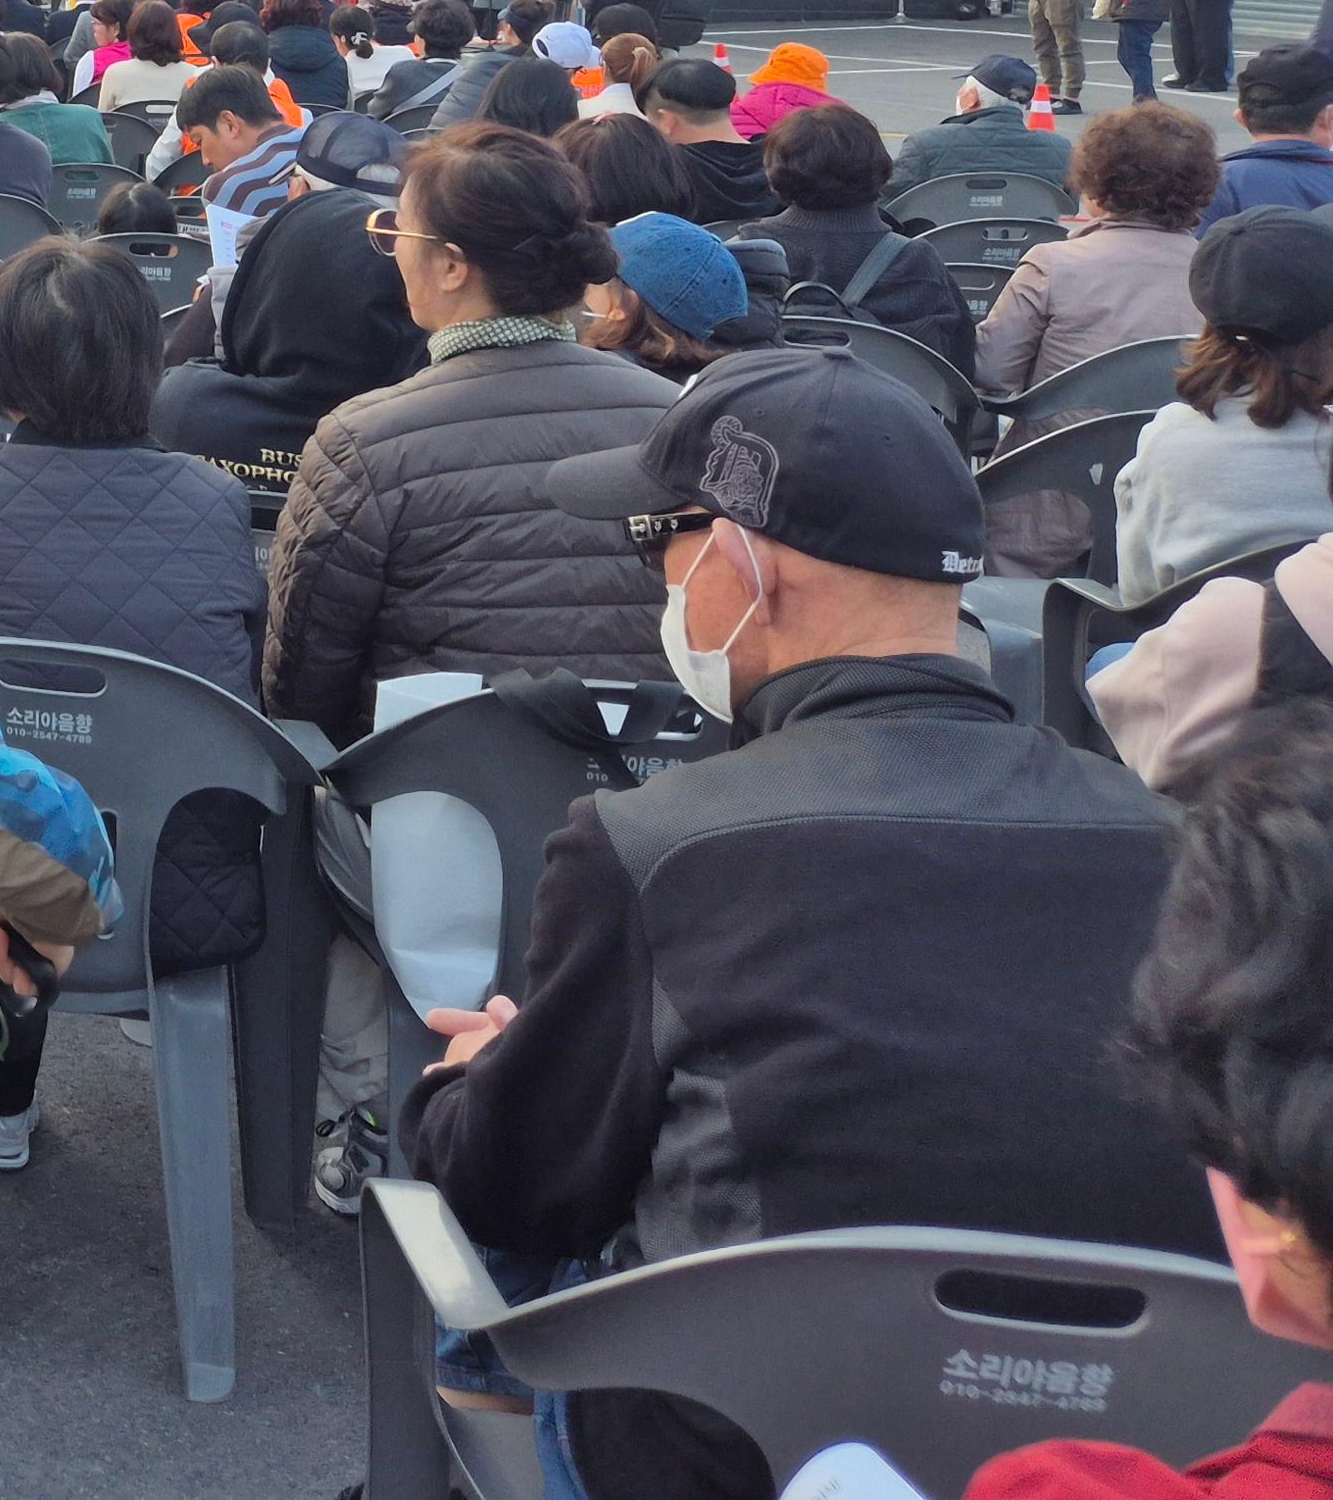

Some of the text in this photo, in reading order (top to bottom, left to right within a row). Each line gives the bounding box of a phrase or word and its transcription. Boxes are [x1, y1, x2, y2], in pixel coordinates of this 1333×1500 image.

[6, 707, 93, 734] 소리아음향
[6, 727, 93, 745] 010-2547-4789
[943, 1348, 1116, 1397] 소리아음향
